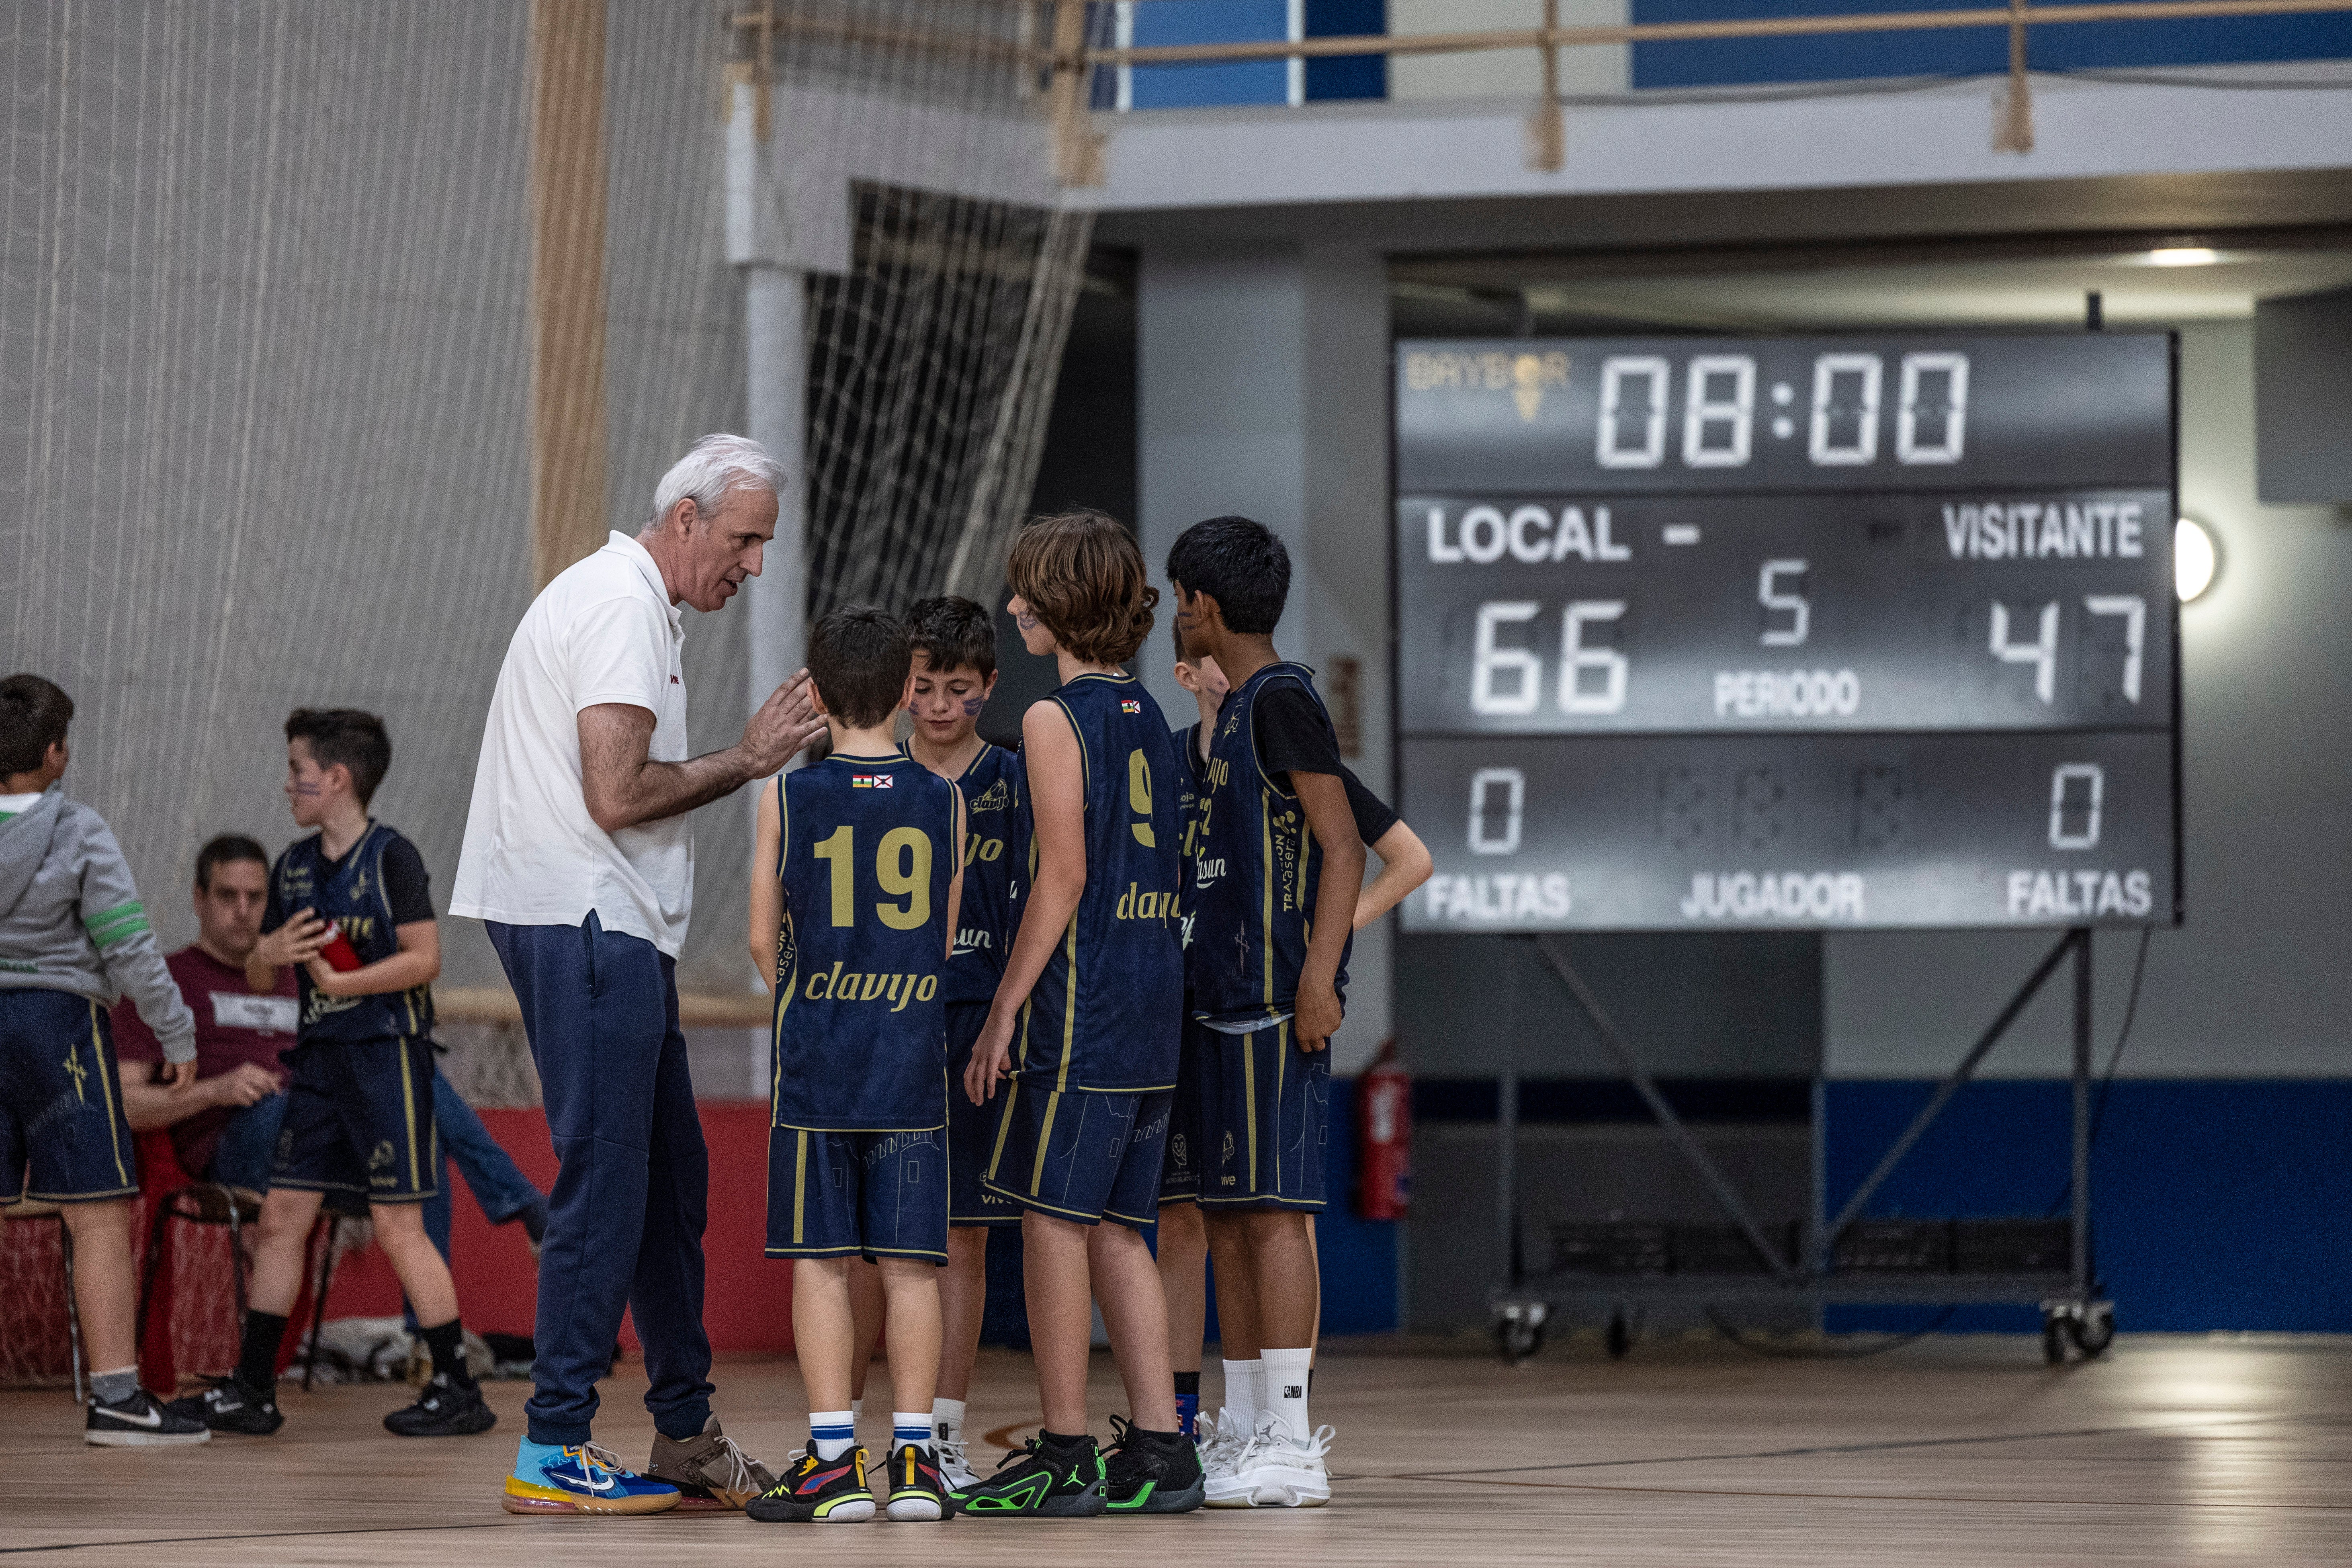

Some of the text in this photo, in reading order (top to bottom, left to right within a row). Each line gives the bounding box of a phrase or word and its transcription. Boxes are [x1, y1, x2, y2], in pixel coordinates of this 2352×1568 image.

[1597, 354, 1968, 467] 08:00
[1429, 507, 1630, 562] LOCAL
[1944, 504, 2142, 558] VISITANTE
[1759, 561, 1808, 644] 5
[1472, 601, 1629, 714] 66
[1989, 597, 2145, 703] 47
[1715, 671, 1860, 716] PERIODO
[1468, 769, 1523, 853] 0
[2049, 764, 2102, 849] 0
[814, 826, 932, 929] 19
[1428, 874, 1571, 919] FALTAS
[1682, 873, 1864, 919] JUGADOR
[2008, 871, 2152, 915] FALTAS
[1290, 1386, 1302, 1398] NBA
